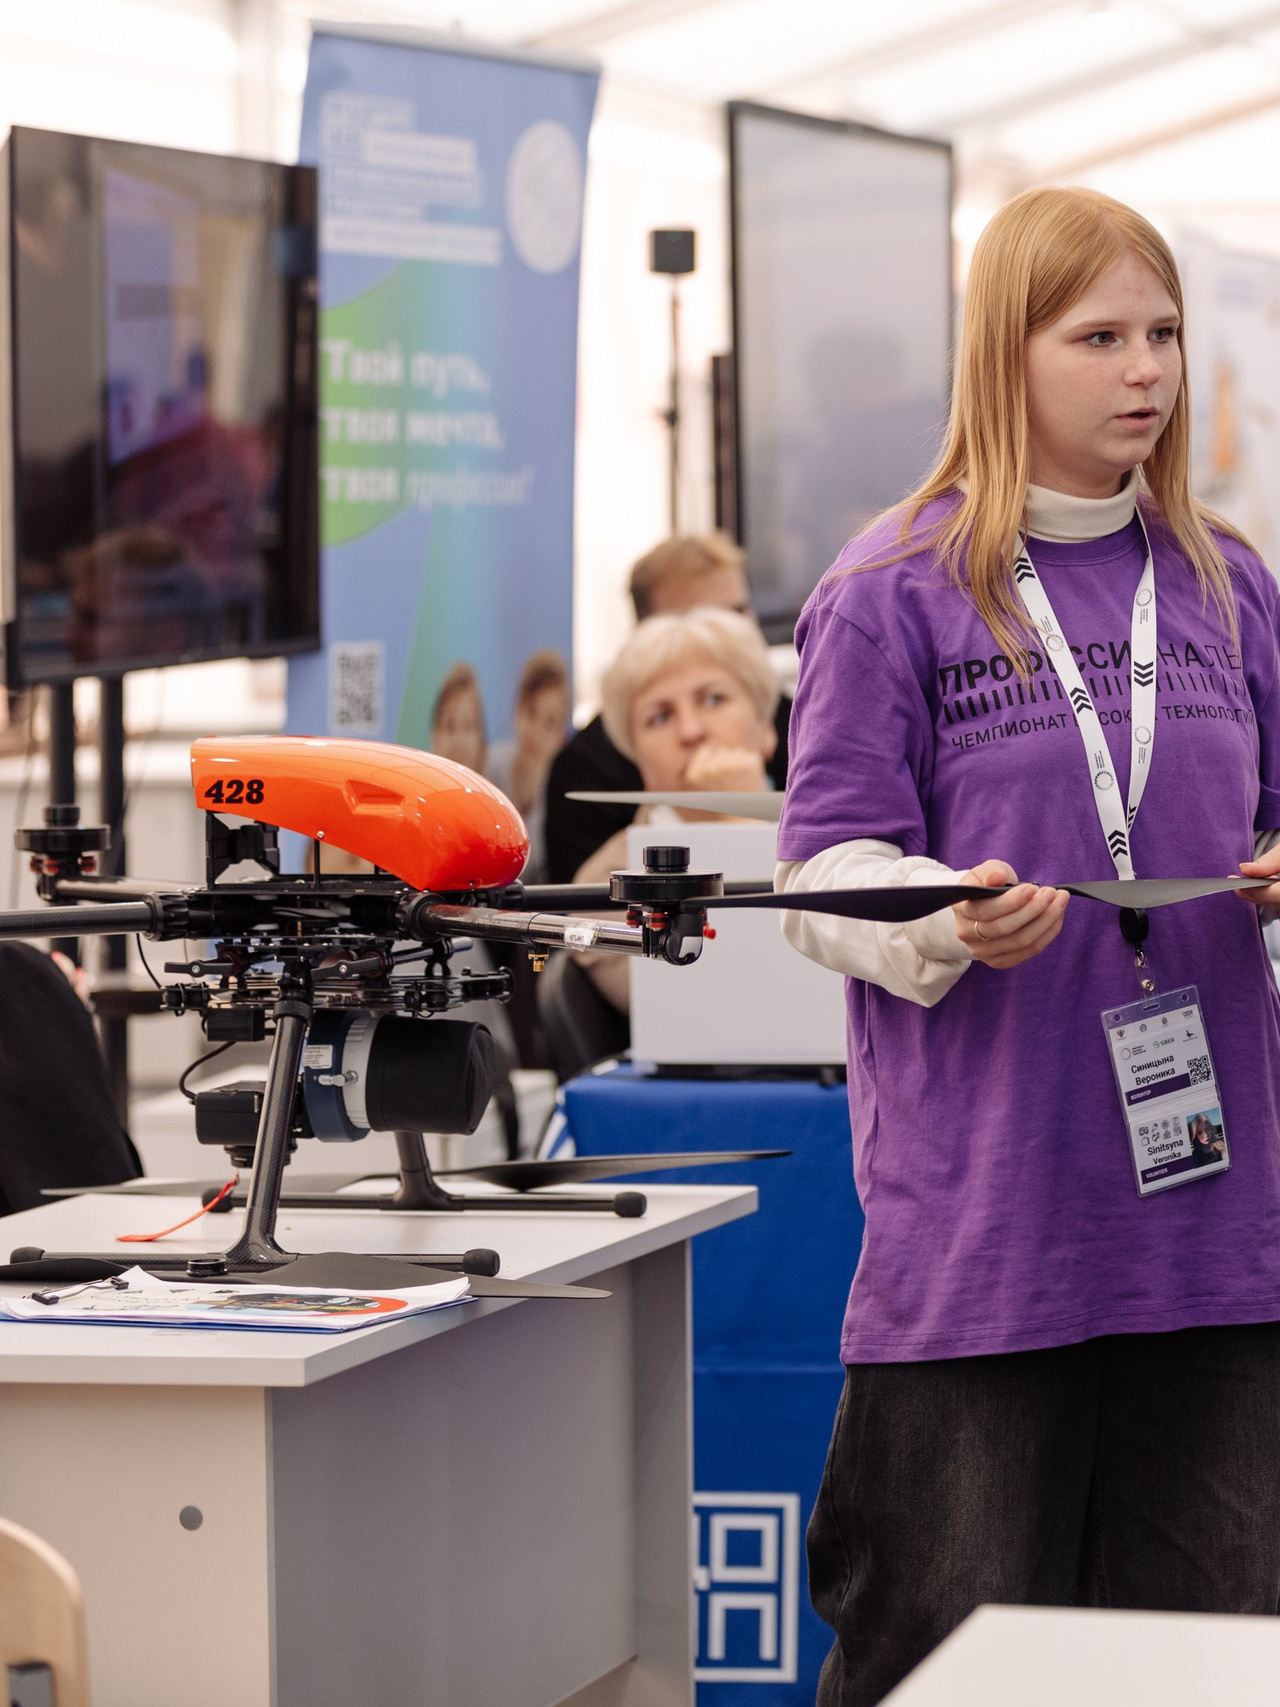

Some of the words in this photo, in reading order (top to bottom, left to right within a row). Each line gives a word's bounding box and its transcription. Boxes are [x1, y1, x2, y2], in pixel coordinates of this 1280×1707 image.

[952, 713, 1067, 750] ЧЕМПИОНАТ
[1162, 704, 1255, 726] ТЕХНОЛОГИЙ
[204, 779, 264, 804] 428
[1131, 1055, 1174, 1074] Синицына
[1135, 1067, 1176, 1085] Вероника
[1147, 1139, 1184, 1156] Sinitsyna
[1153, 1151, 1181, 1164] Veronika
[1145, 1167, 1168, 1178] VOLUNTEER
